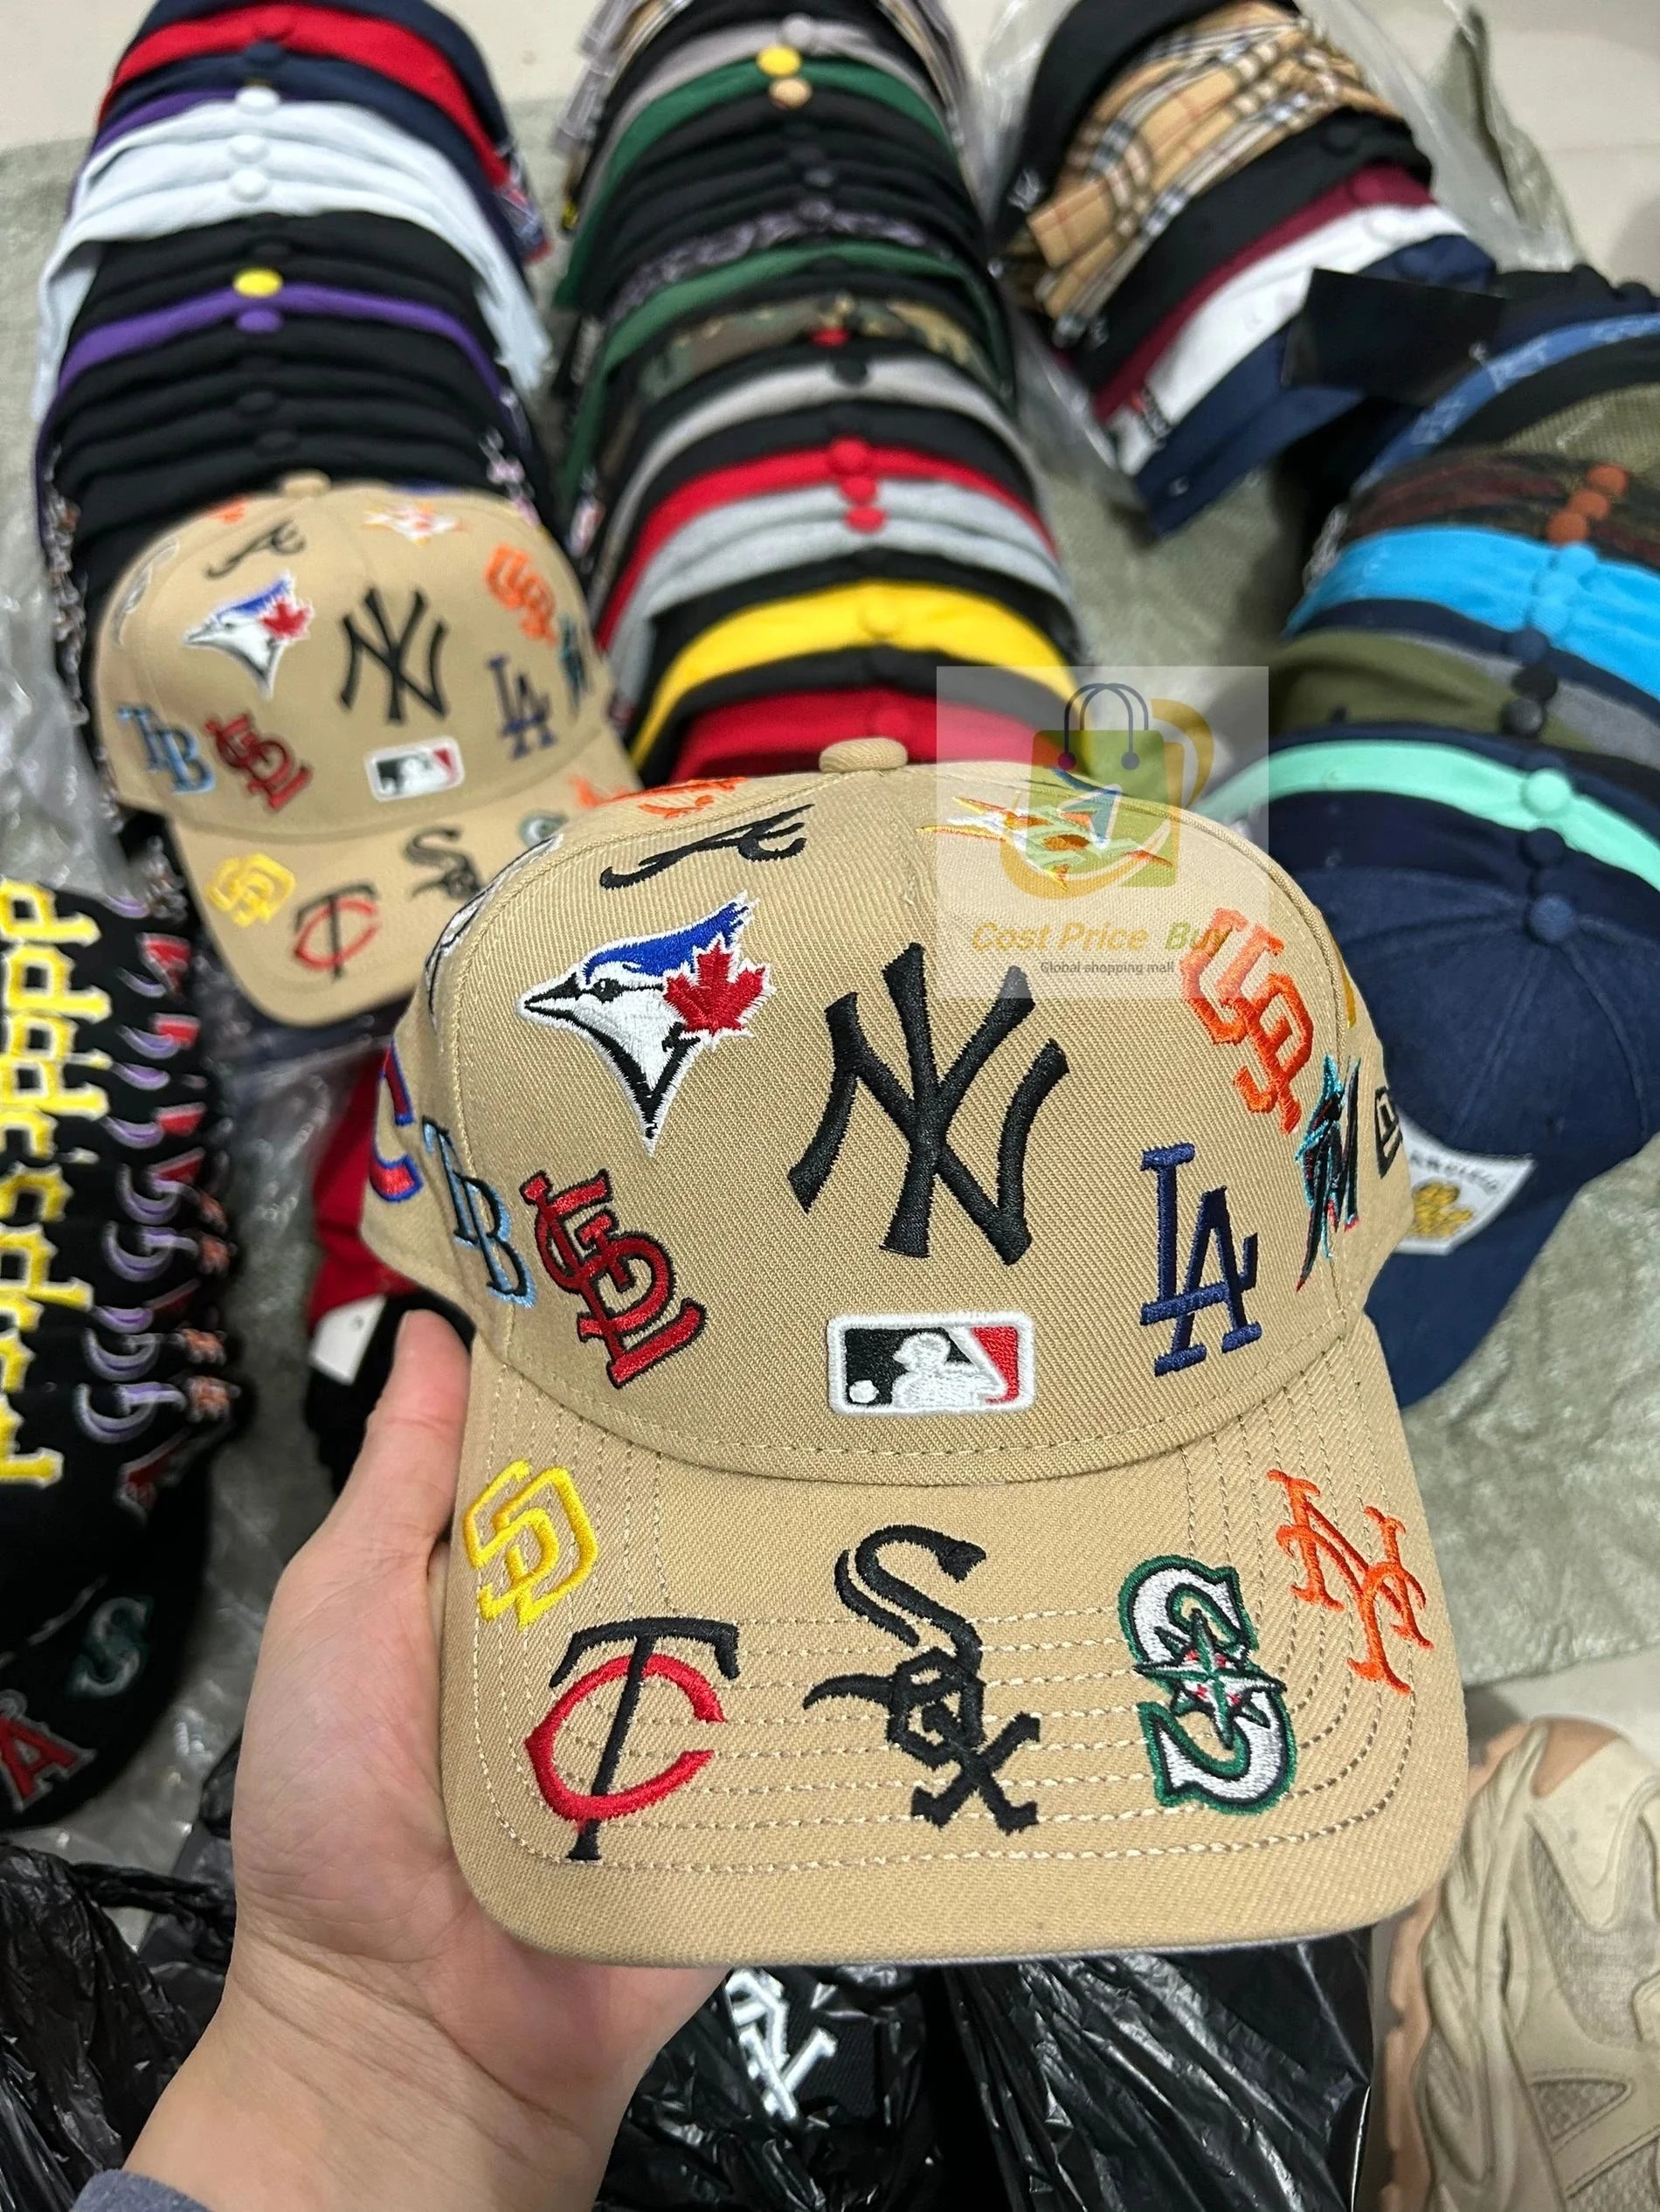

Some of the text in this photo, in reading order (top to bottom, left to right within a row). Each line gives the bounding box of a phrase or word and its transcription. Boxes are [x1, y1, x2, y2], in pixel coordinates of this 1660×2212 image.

[118, 704, 216, 795] TB
[337, 586, 450, 725] NY
[487, 653, 560, 760] LA
[787, 942, 1070, 1268] NY
[1179, 907, 1313, 1136] SF
[422, 1114, 538, 1309] TB
[1138, 1141, 1263, 1378] LA
[462, 1458, 598, 1631] SD
[1267, 1468, 1435, 1697] NY
[1117, 1553, 1297, 1816] S
